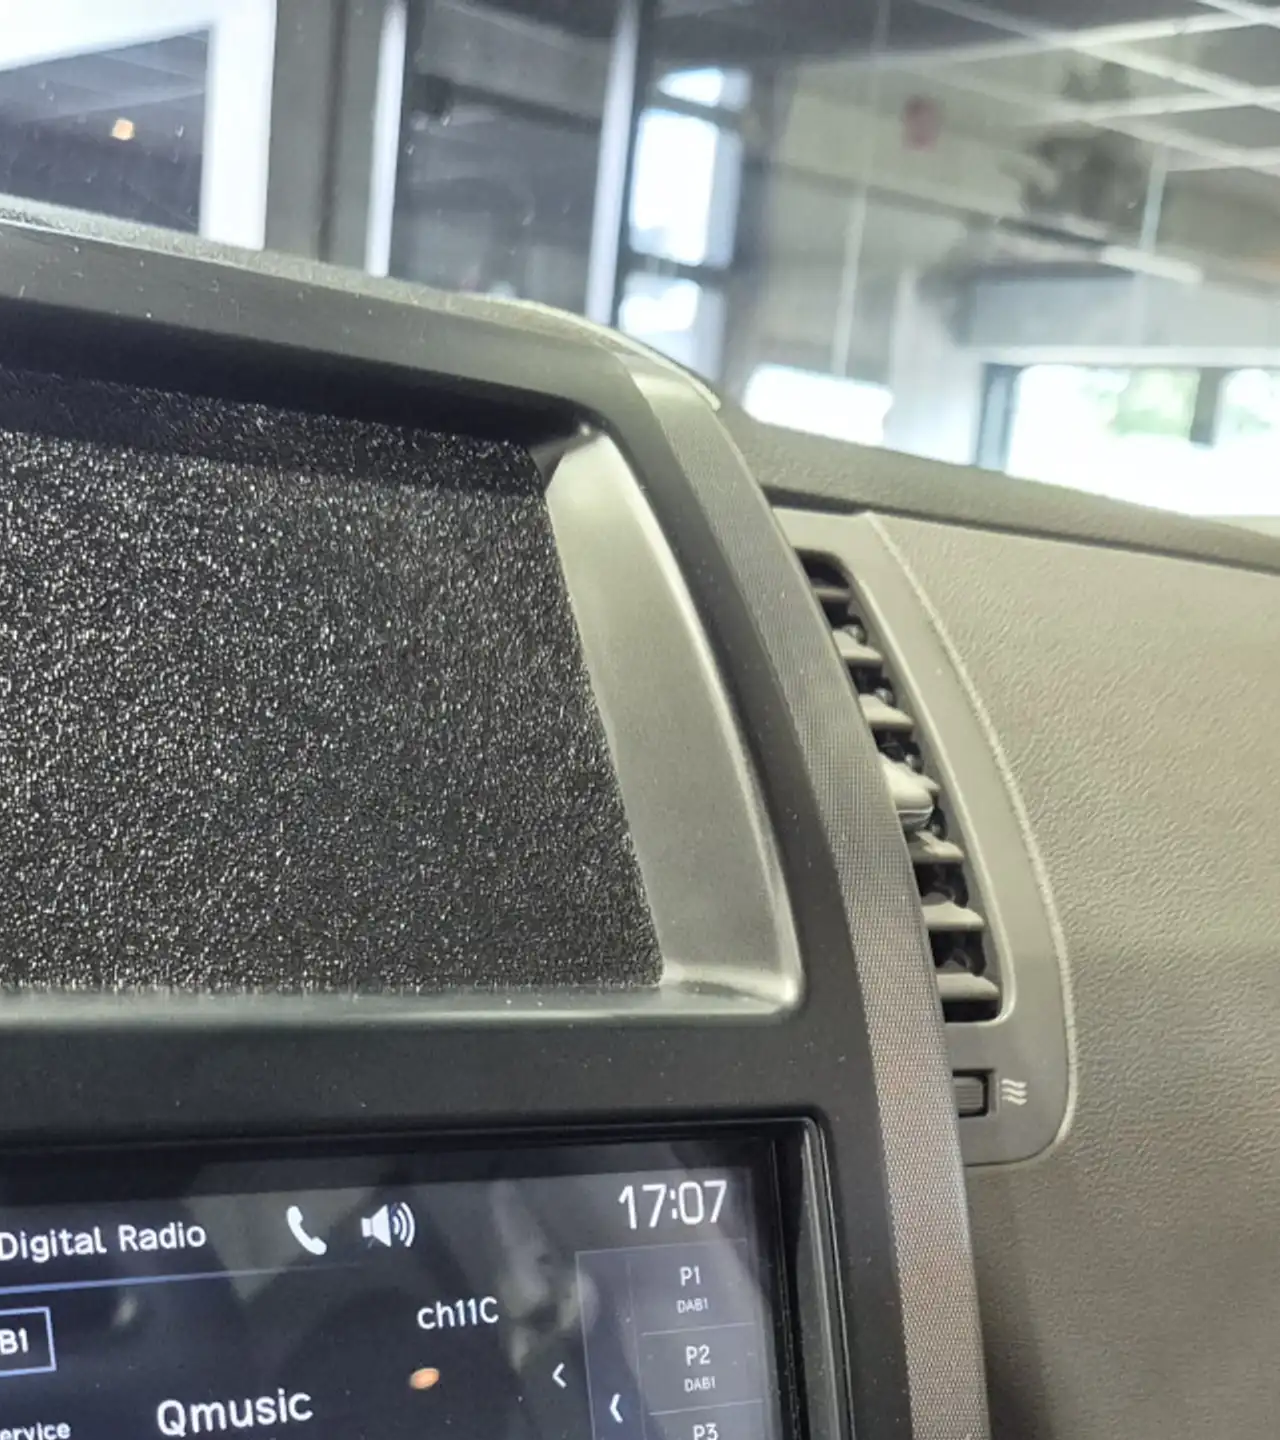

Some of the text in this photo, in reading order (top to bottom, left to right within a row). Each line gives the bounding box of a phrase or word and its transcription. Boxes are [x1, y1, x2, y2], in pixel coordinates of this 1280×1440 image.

[618, 1180, 728, 1229] 17:07
[119, 1221, 207, 1252] Radio
[680, 1266, 701, 1286] P1
[417, 1297, 500, 1330] ch11C
[676, 1296, 709, 1314] DAB1
[685, 1345, 711, 1366] P2
[684, 1375, 716, 1393] DAB1
[157, 1387, 313, 1436] Qmusic
